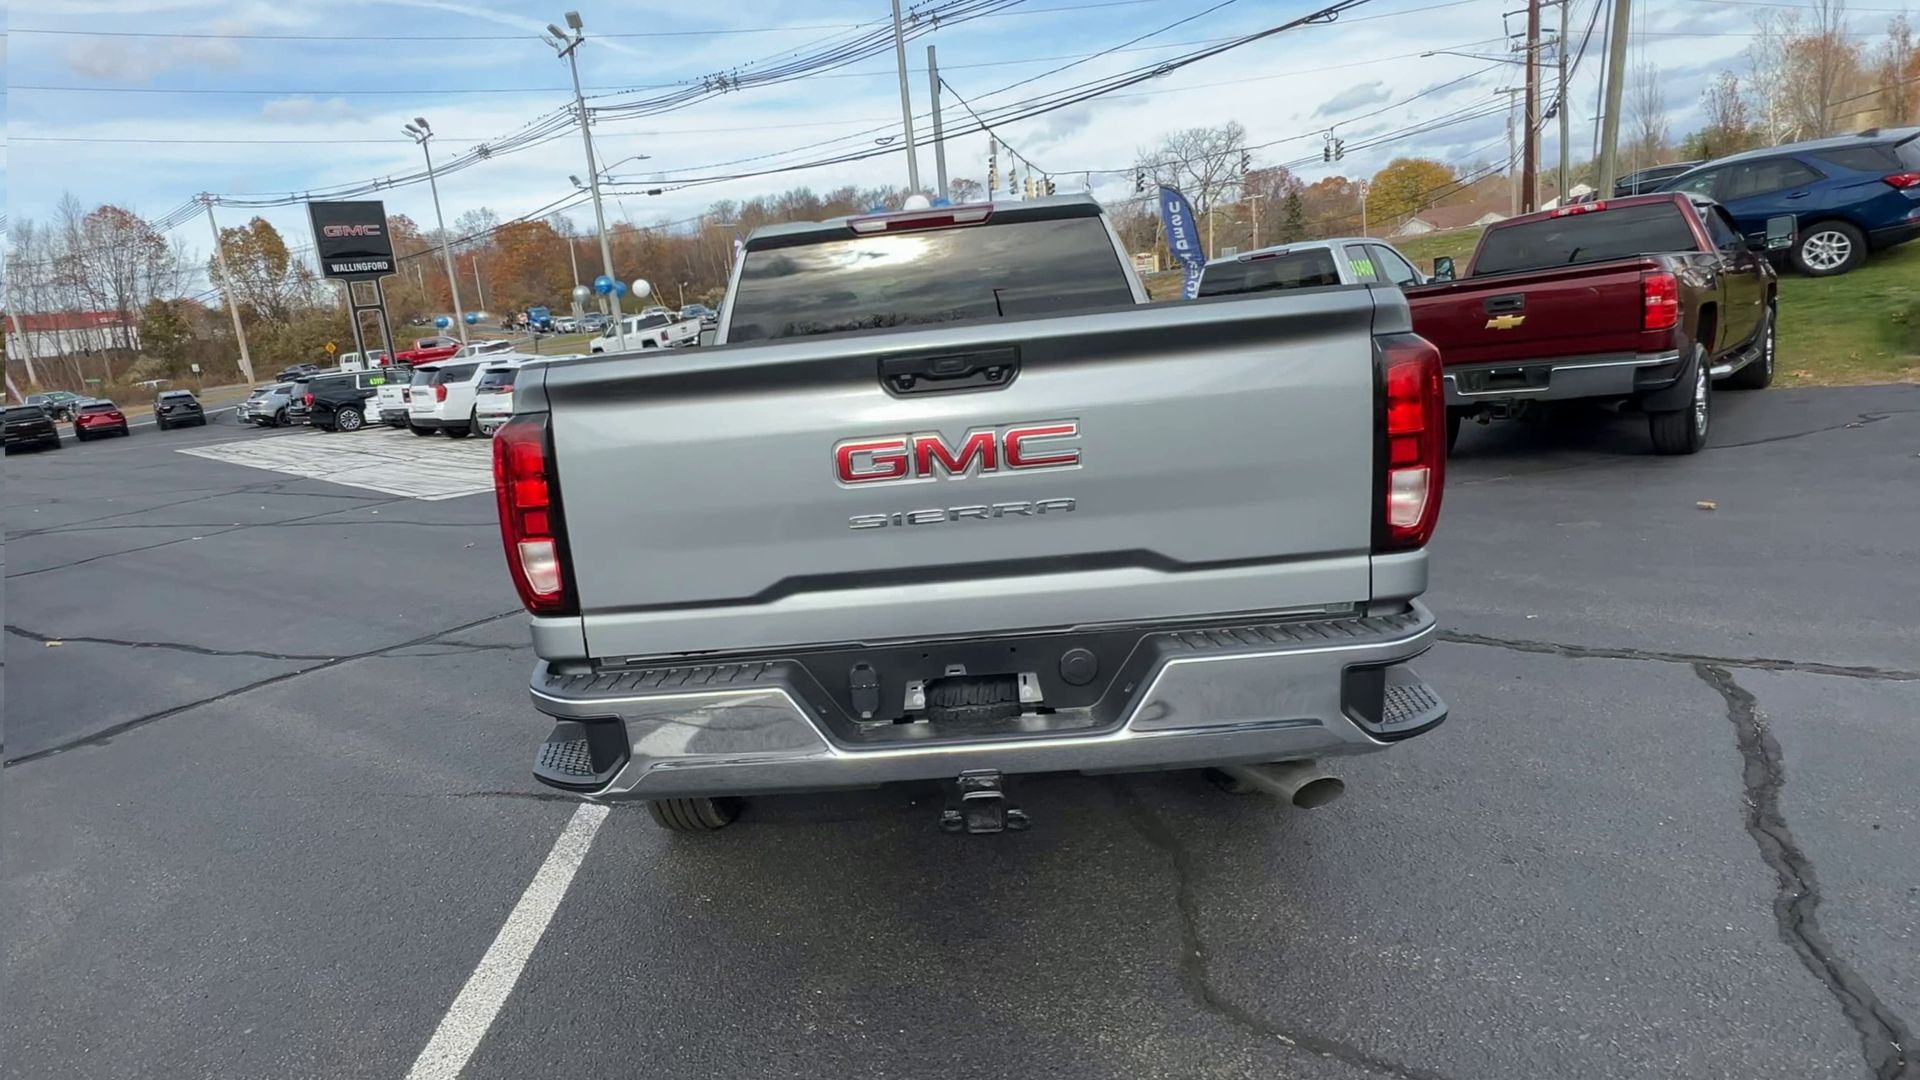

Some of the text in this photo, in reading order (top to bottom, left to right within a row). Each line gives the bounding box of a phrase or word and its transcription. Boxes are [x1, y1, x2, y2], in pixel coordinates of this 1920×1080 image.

[324, 225, 381, 237] GMC
[331, 262, 388, 272] WALLINGFORD
[834, 422, 1081, 486] GMC
[848, 497, 1077, 530] SIERRA
